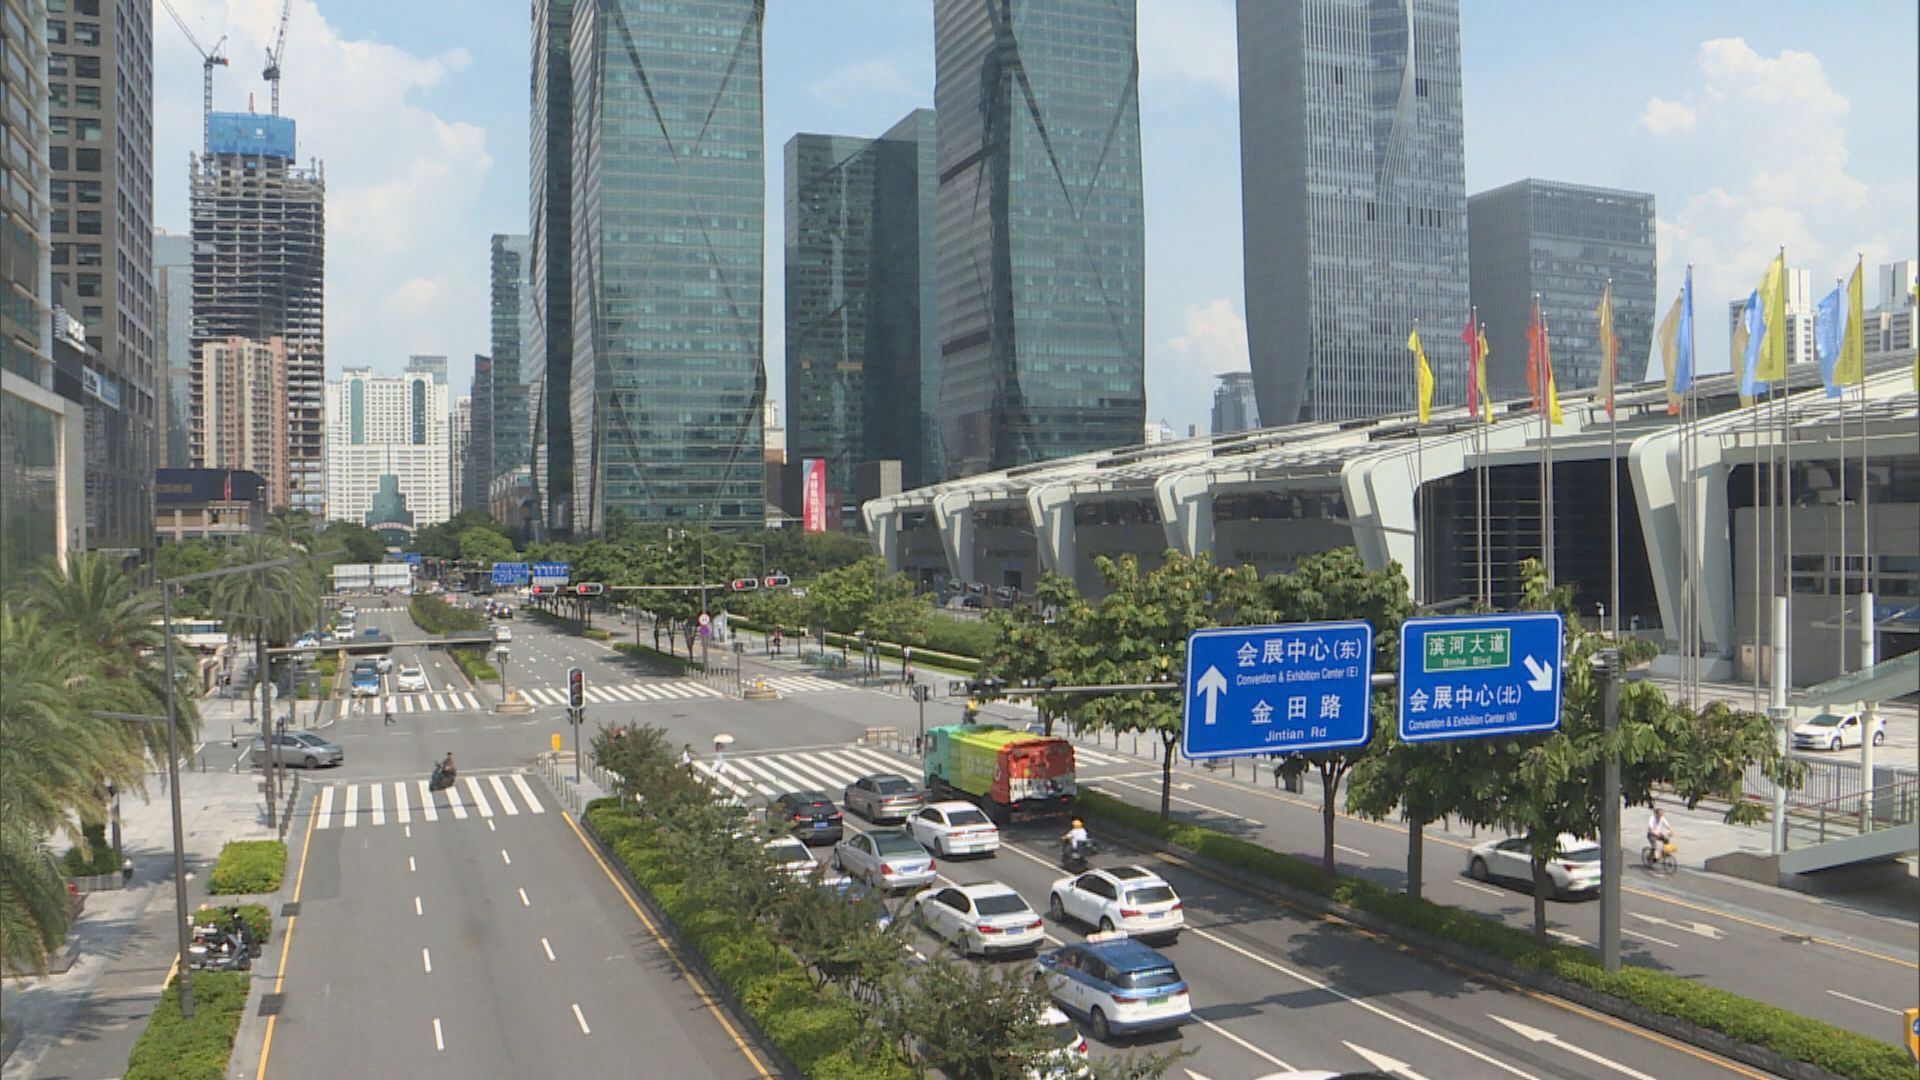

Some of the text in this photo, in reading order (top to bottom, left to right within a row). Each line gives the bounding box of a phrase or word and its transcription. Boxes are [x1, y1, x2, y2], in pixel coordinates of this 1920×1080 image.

[1237, 637, 1361, 667] 会展中心(东)
[1429, 634, 1505, 656] 滨河大道
[1443, 656, 1492, 667] Binhe Blvd
[1236, 666, 1359, 686] Convention & Exhibition Center (E)
[1409, 684, 1522, 712] 会展中心(北)
[1251, 694, 1342, 725] 金田路
[1408, 711, 1518, 731] Convention & Exhibition Center (N)
[1265, 726, 1327, 742] Jintian Rd
